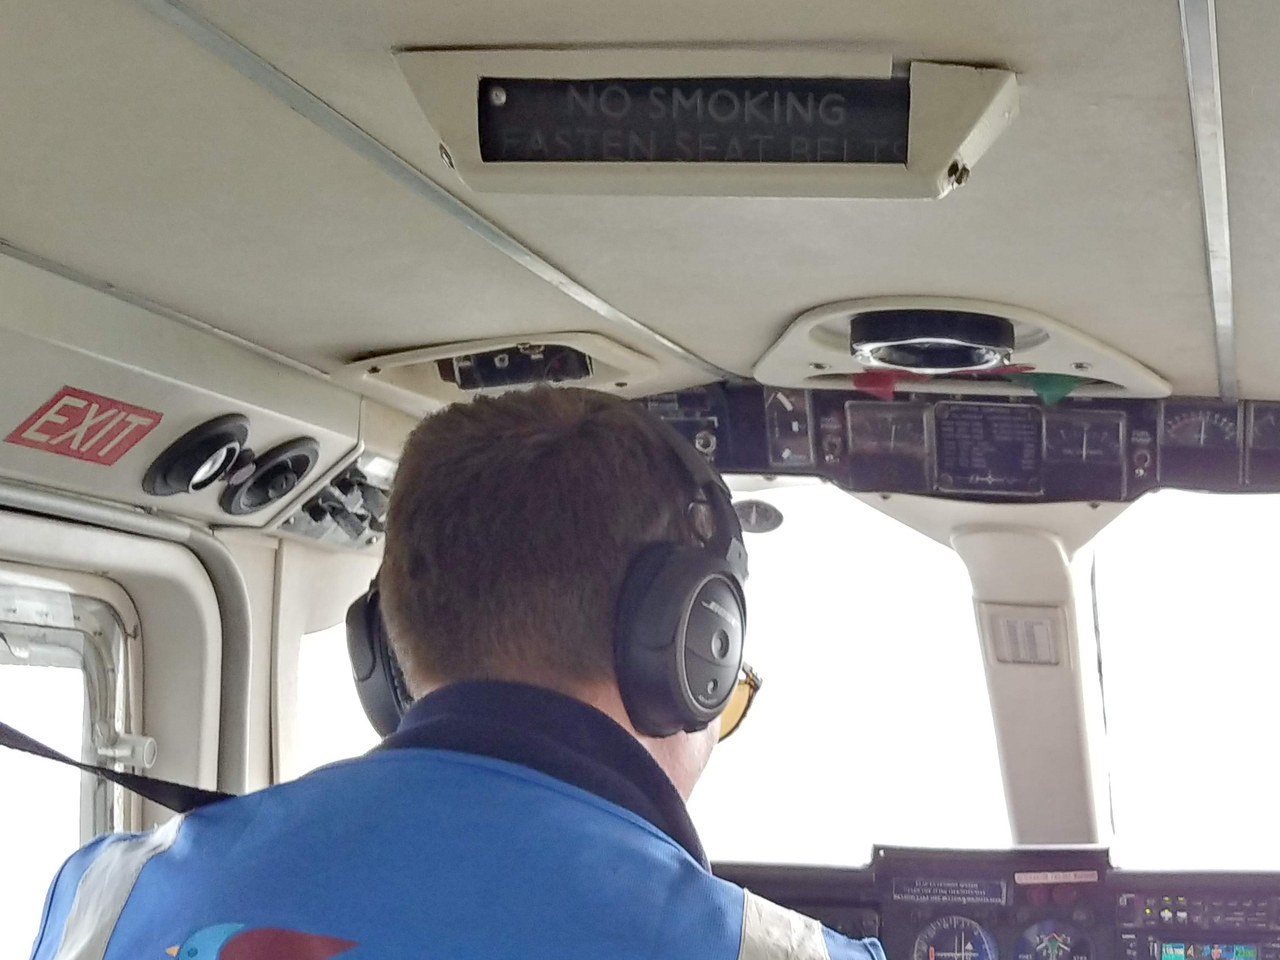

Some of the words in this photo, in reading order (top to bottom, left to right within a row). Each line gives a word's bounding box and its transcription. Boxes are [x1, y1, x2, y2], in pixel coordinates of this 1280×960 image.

[566, 84, 632, 118] NO
[648, 86, 848, 126] SMOKING
[501, 127, 657, 161] FASTEN
[675, 133, 774, 162] SEAT
[20, 394, 155, 458] EXIT
